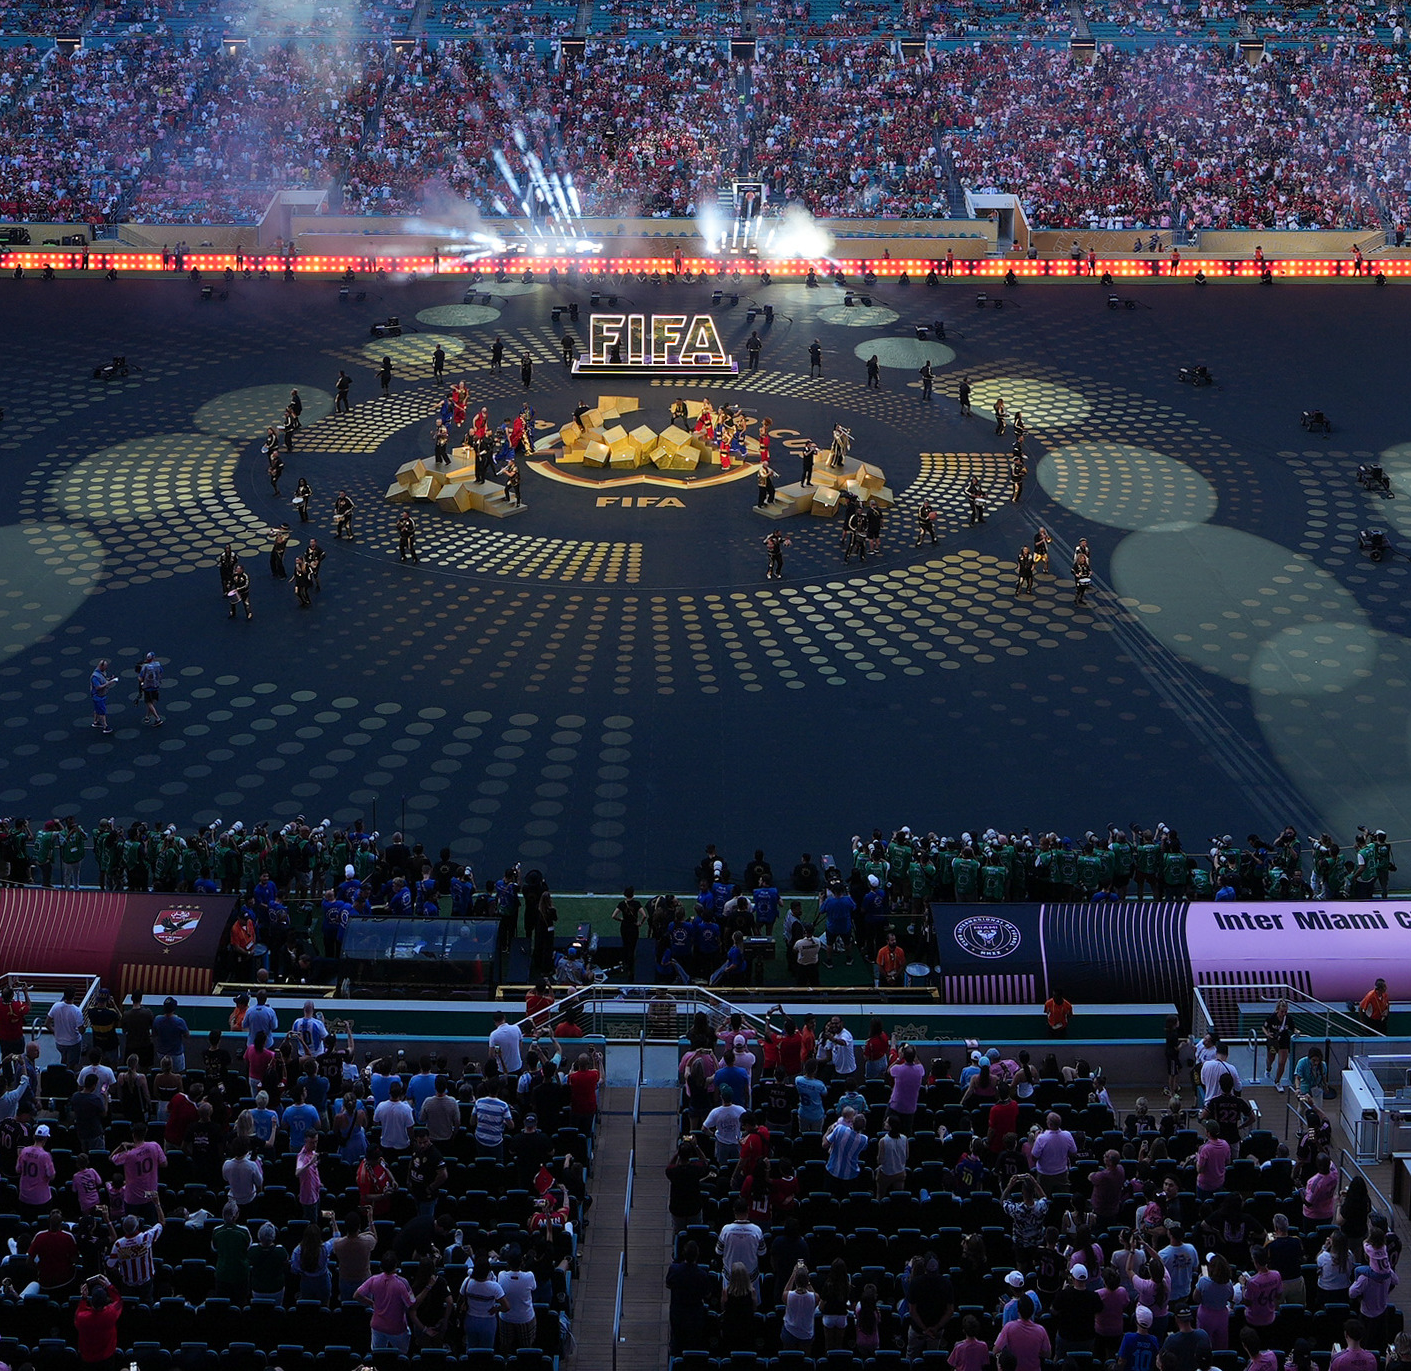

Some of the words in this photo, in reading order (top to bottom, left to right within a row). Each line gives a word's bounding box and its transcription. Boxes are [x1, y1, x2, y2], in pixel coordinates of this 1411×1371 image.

[589, 313, 727, 366] FIFA
[595, 495, 687, 508] FIFA
[1213, 911, 1283, 931] Inter
[1294, 911, 1388, 931] Miami
[22, 1160, 38, 1178] 10
[134, 1157, 153, 1176] 10
